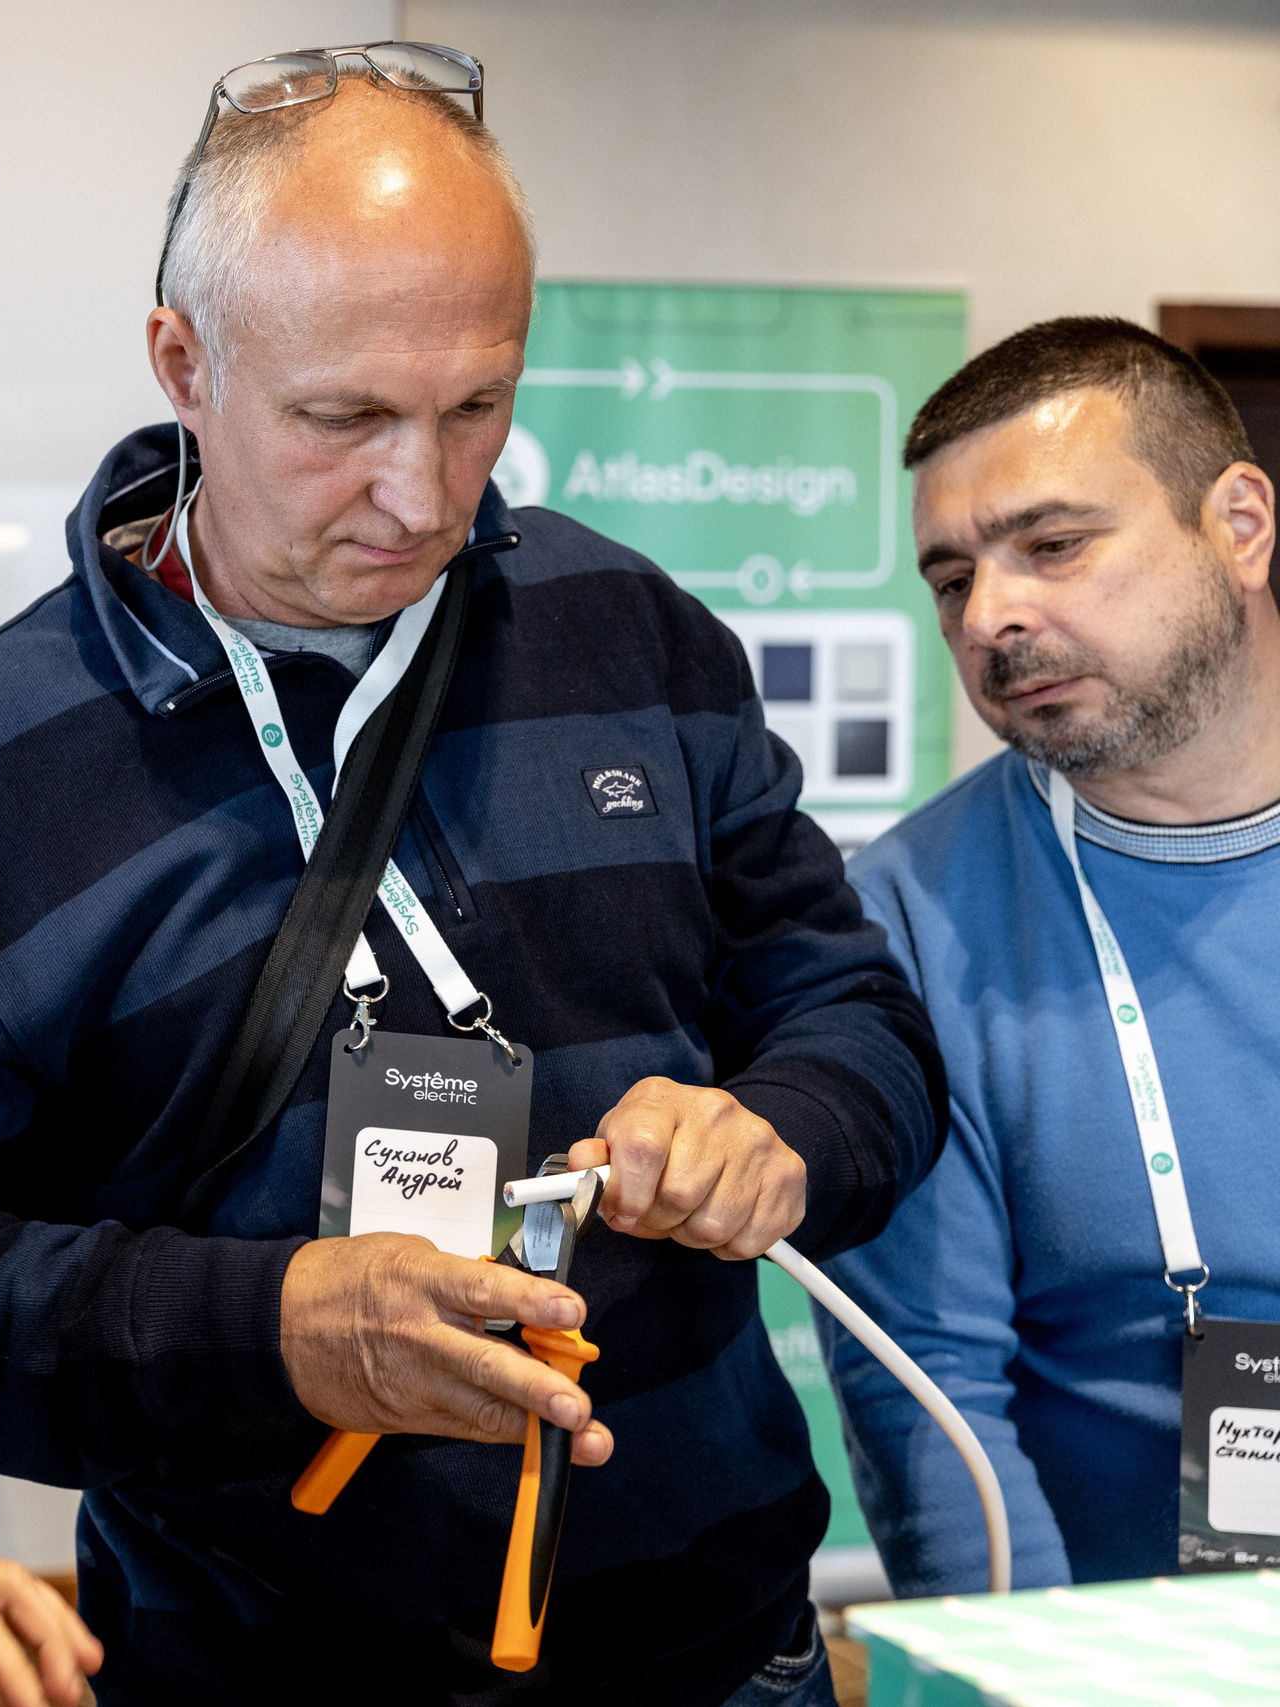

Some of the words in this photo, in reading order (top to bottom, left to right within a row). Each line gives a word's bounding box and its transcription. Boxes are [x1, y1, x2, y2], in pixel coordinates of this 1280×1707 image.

[564, 451, 856, 516] AtlasDesign
[230, 632, 264, 693] Systême
[230, 649, 253, 697] electric
[292, 796, 312, 848] electric
[380, 872, 419, 936] Systêm
[386, 863, 417, 907] electric
[384, 1068, 478, 1092] Systême
[413, 1088, 477, 1105] electric
[364, 1139, 458, 1167] Суханов
[380, 1167, 464, 1200] Андрей
[1234, 1352, 1280, 1374] Syst
